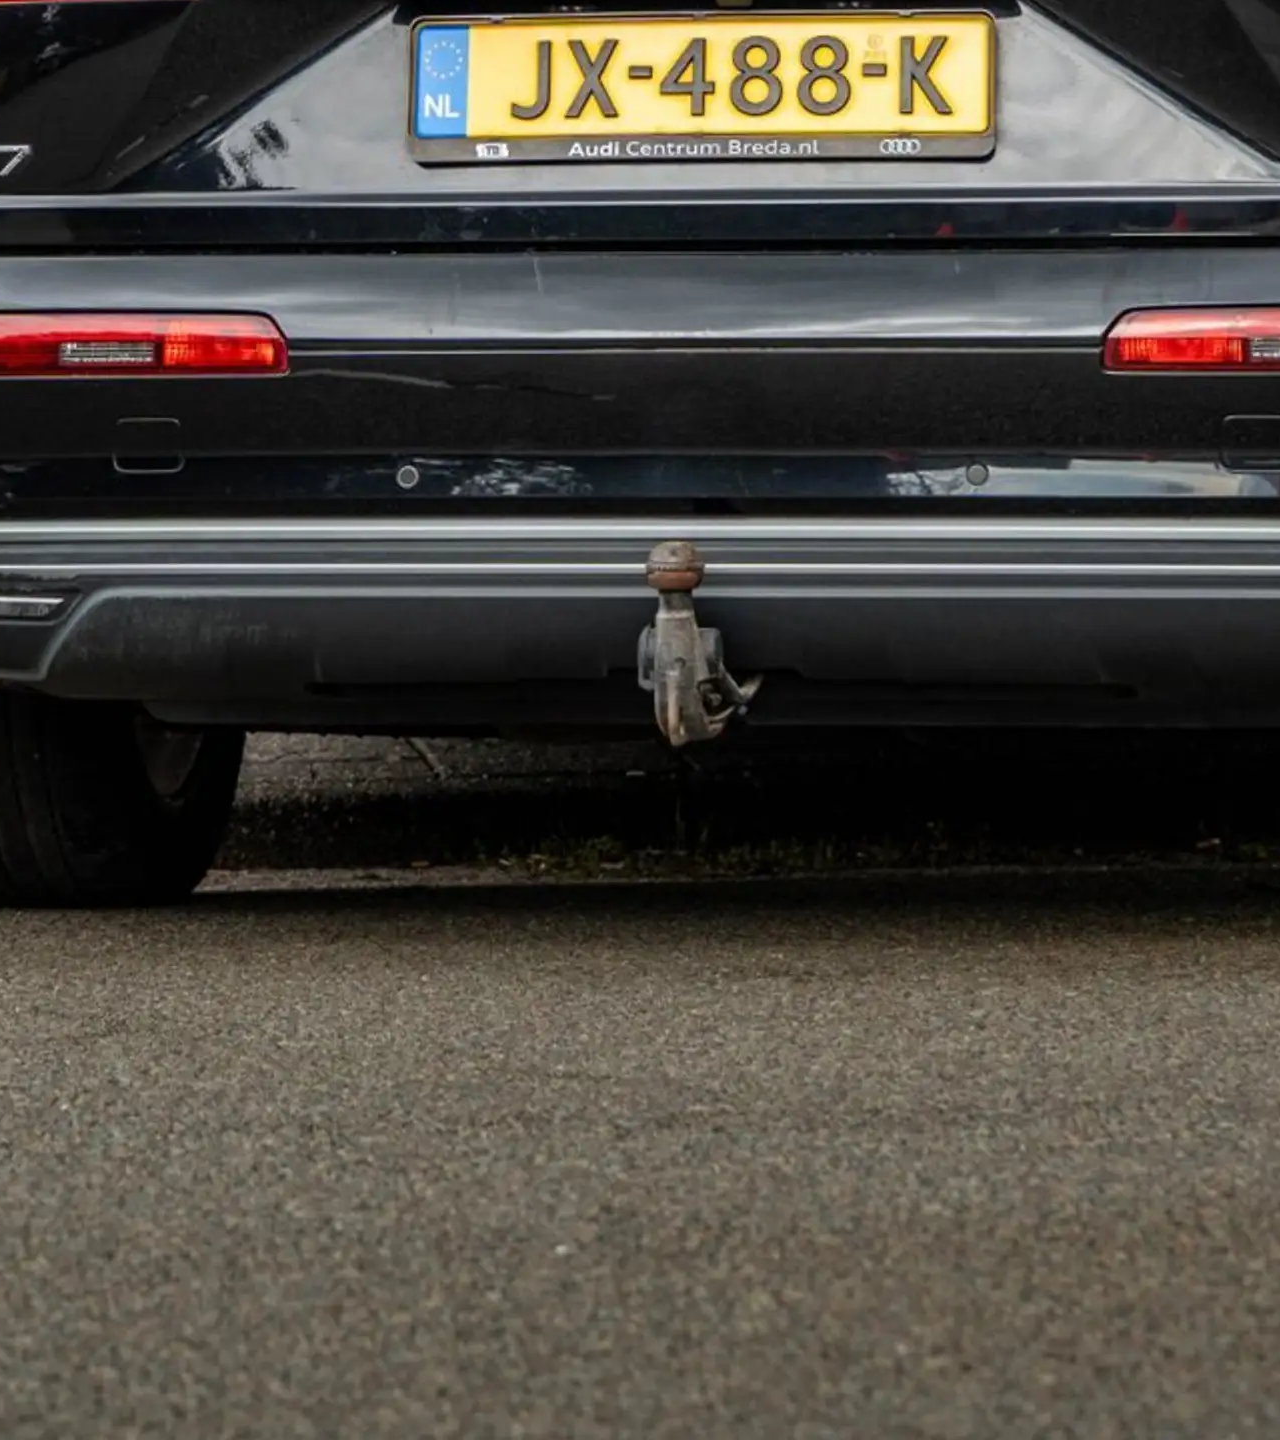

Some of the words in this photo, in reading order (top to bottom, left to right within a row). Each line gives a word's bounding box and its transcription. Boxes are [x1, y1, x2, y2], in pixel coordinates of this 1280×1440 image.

[510, 35, 954, 120] JX-488-K
[423, 93, 460, 118] NL
[568, 141, 620, 157] Audi
[626, 140, 720, 156] Centrum
[728, 139, 819, 155] Breda.nl
